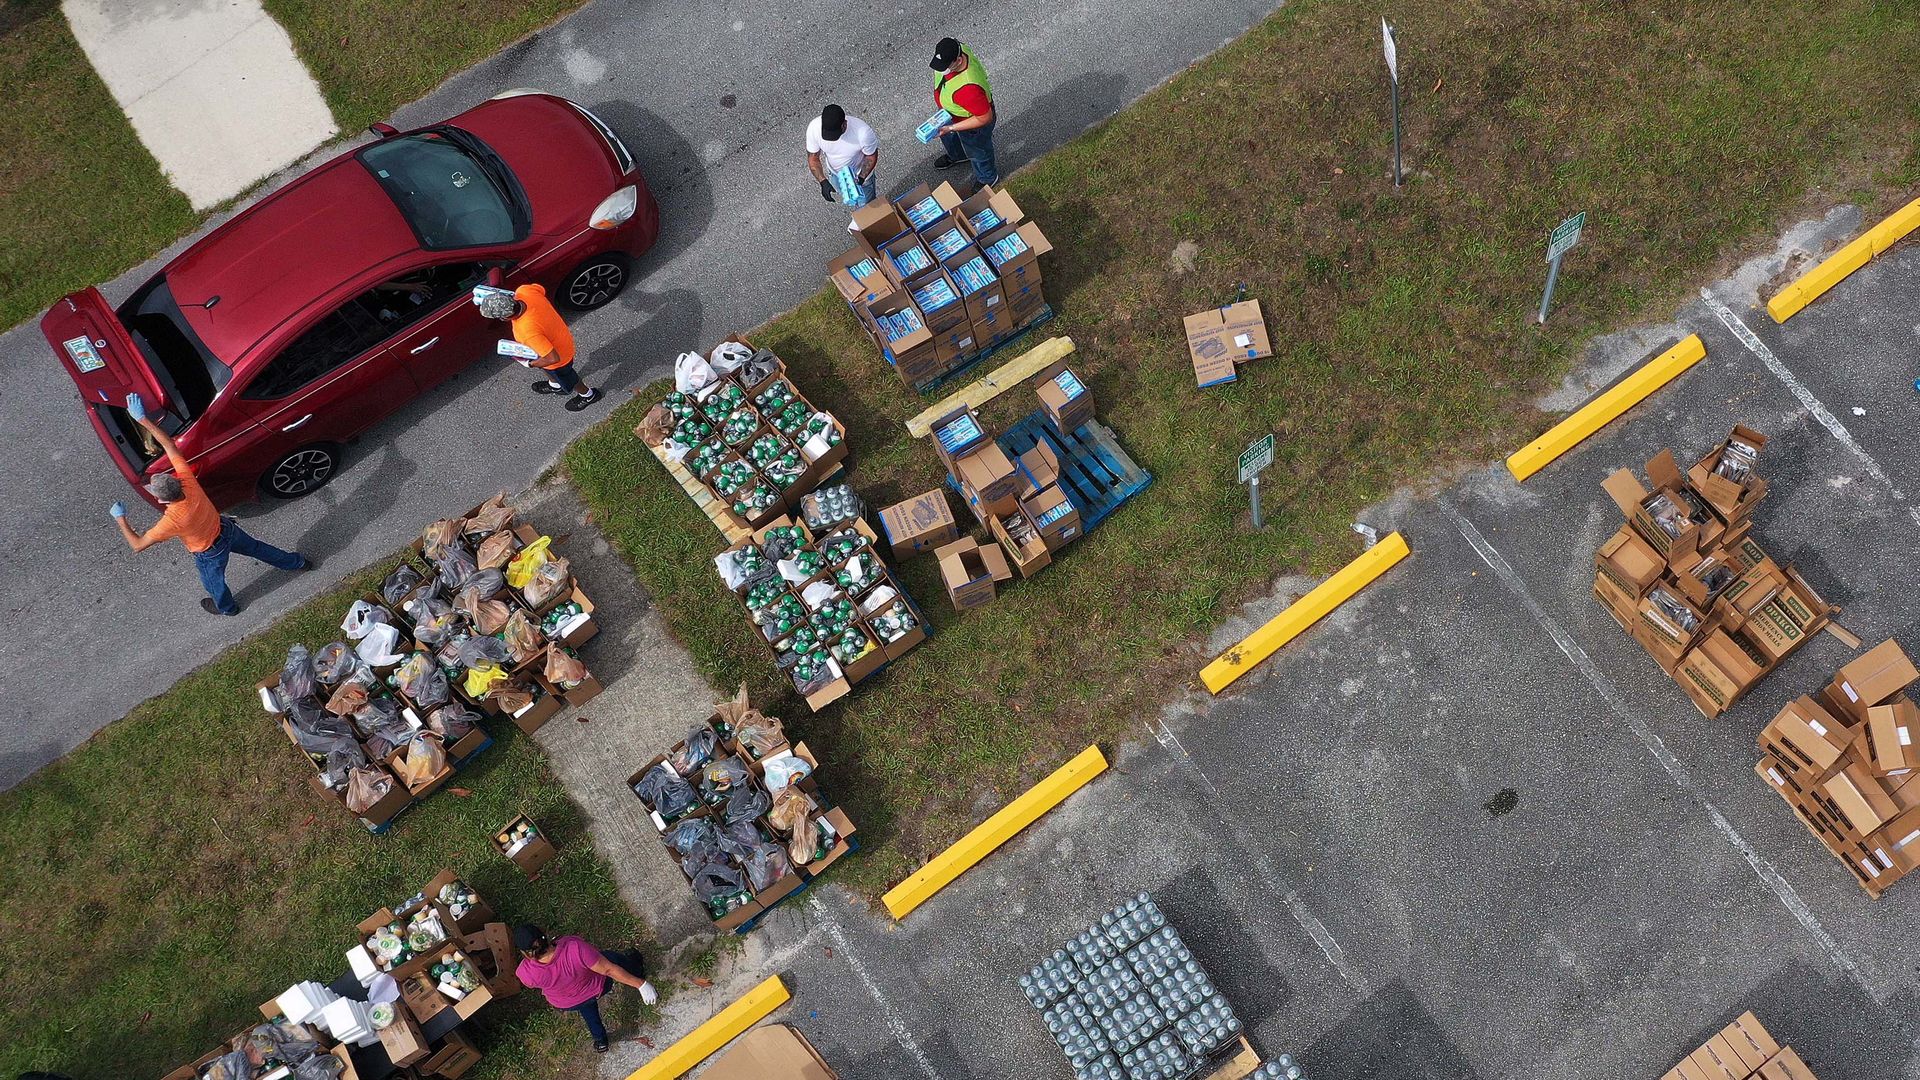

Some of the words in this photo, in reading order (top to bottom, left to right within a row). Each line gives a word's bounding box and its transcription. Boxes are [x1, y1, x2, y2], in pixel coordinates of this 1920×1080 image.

[1241, 442, 1269, 466] PARKING
[1243, 438, 1267, 459] VISITOR
[1743, 542, 1763, 562] SOP
[1751, 617, 1766, 632] ATION
[1764, 630, 1782, 648] MEALS
[1756, 612, 1784, 641] MERGENCY
[1763, 604, 1798, 637] OPAKCO
